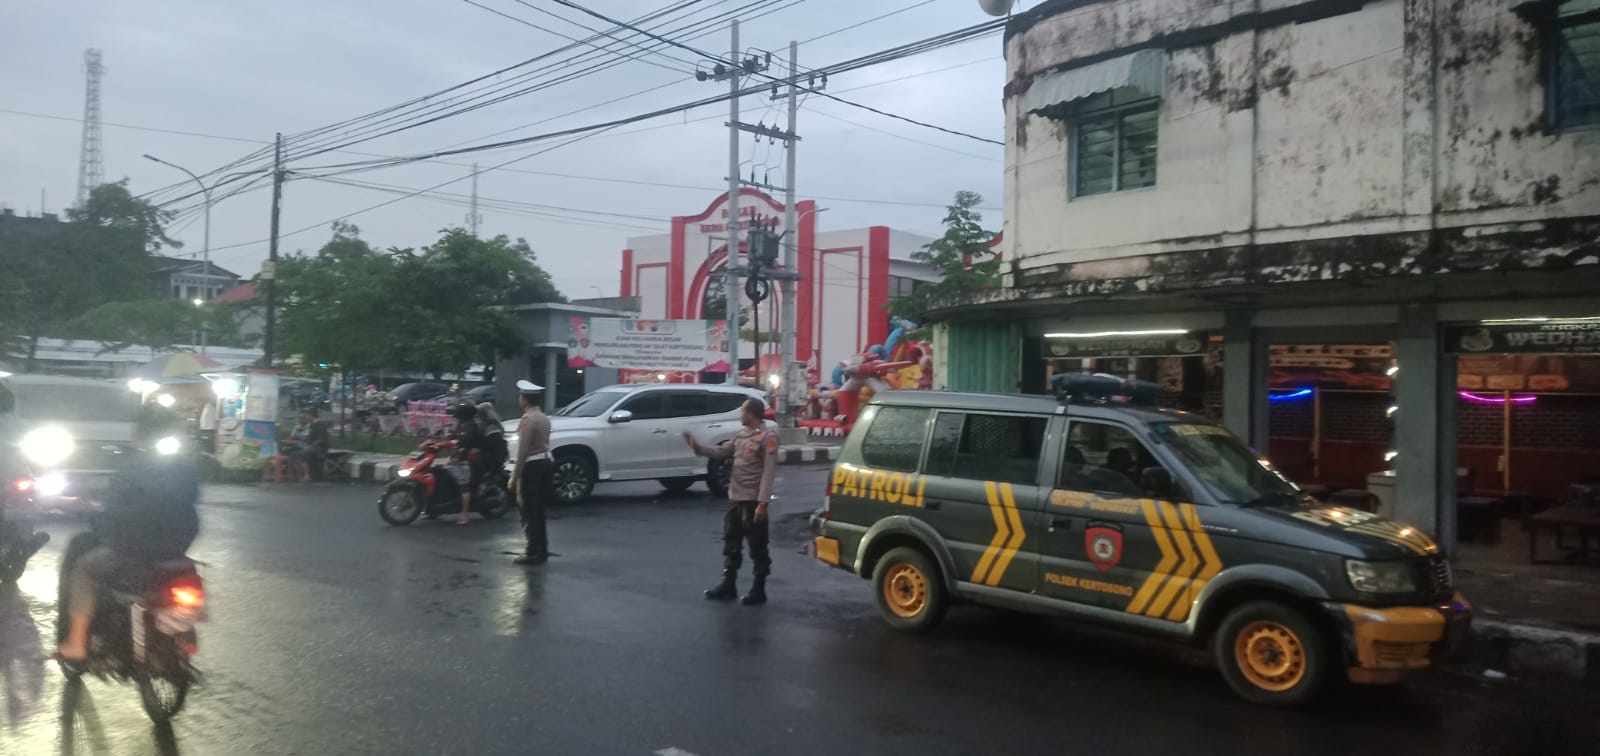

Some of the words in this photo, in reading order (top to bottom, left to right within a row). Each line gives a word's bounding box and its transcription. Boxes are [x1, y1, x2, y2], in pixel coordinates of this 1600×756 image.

[831, 464, 928, 508] PATROLI
[1044, 572, 1078, 587] POLSEK
[1079, 578, 1134, 597] KERTOSONO
